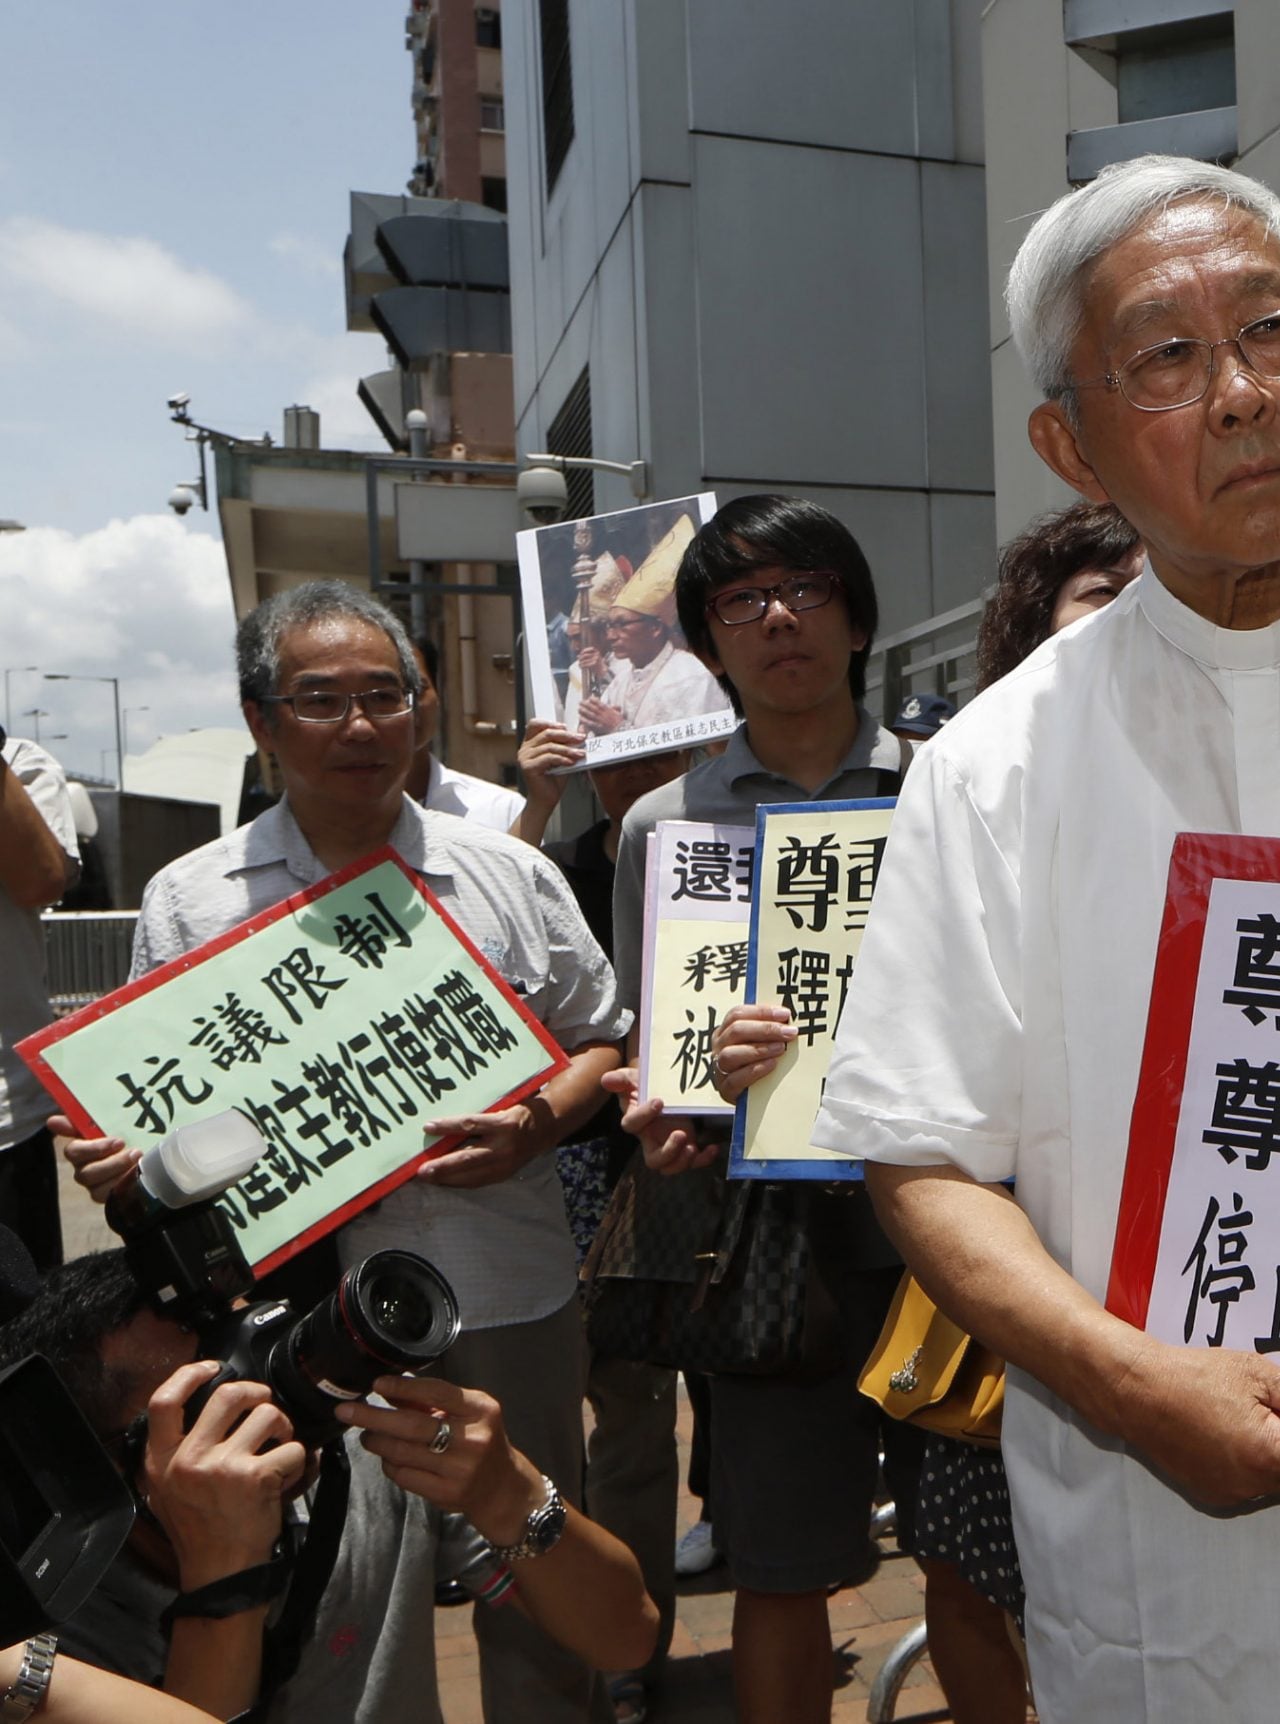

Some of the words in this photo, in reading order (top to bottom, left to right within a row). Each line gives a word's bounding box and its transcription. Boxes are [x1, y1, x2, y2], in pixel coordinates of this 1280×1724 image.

[611, 717, 742, 753] 河北保定教區蘇志民主
[117, 891, 412, 1134] 抗議限制
[776, 946, 853, 1051] 釋
[254, 1305, 287, 1325] Canon
